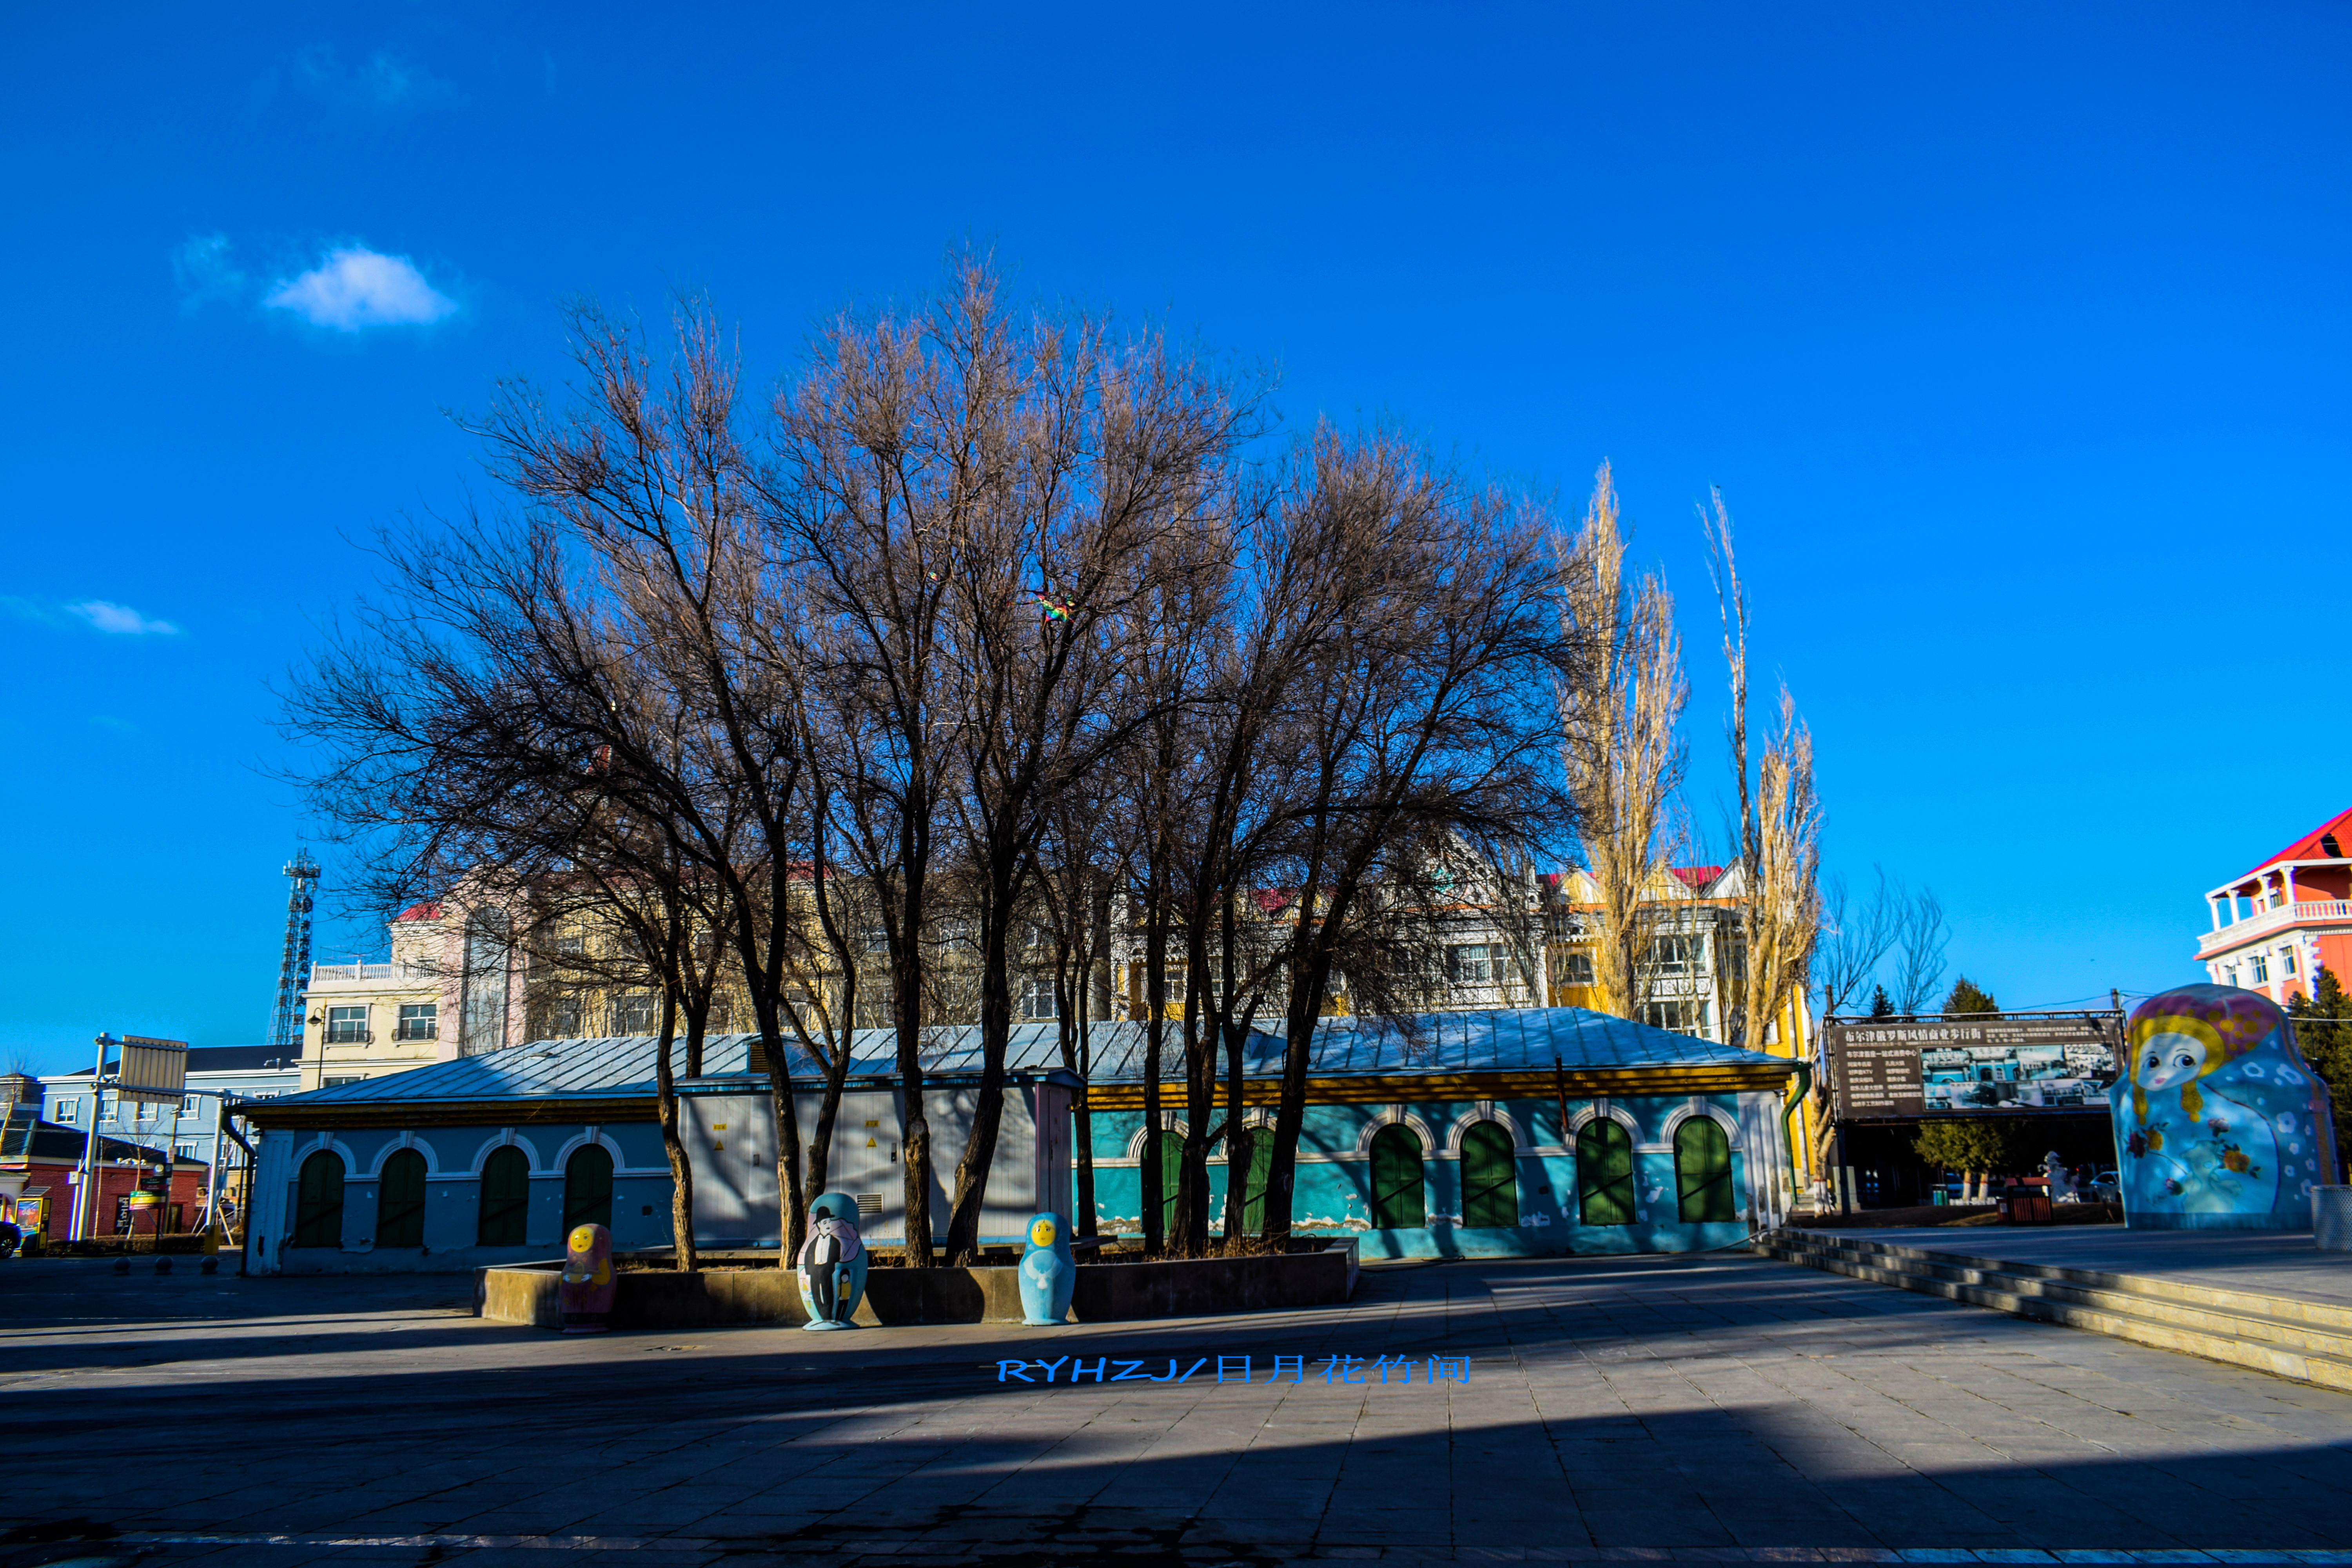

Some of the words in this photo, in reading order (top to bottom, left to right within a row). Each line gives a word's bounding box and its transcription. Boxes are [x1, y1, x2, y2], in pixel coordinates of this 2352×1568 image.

[1845, 1028, 1981, 1042] 布尔津俄罗斯风情商业步行街
